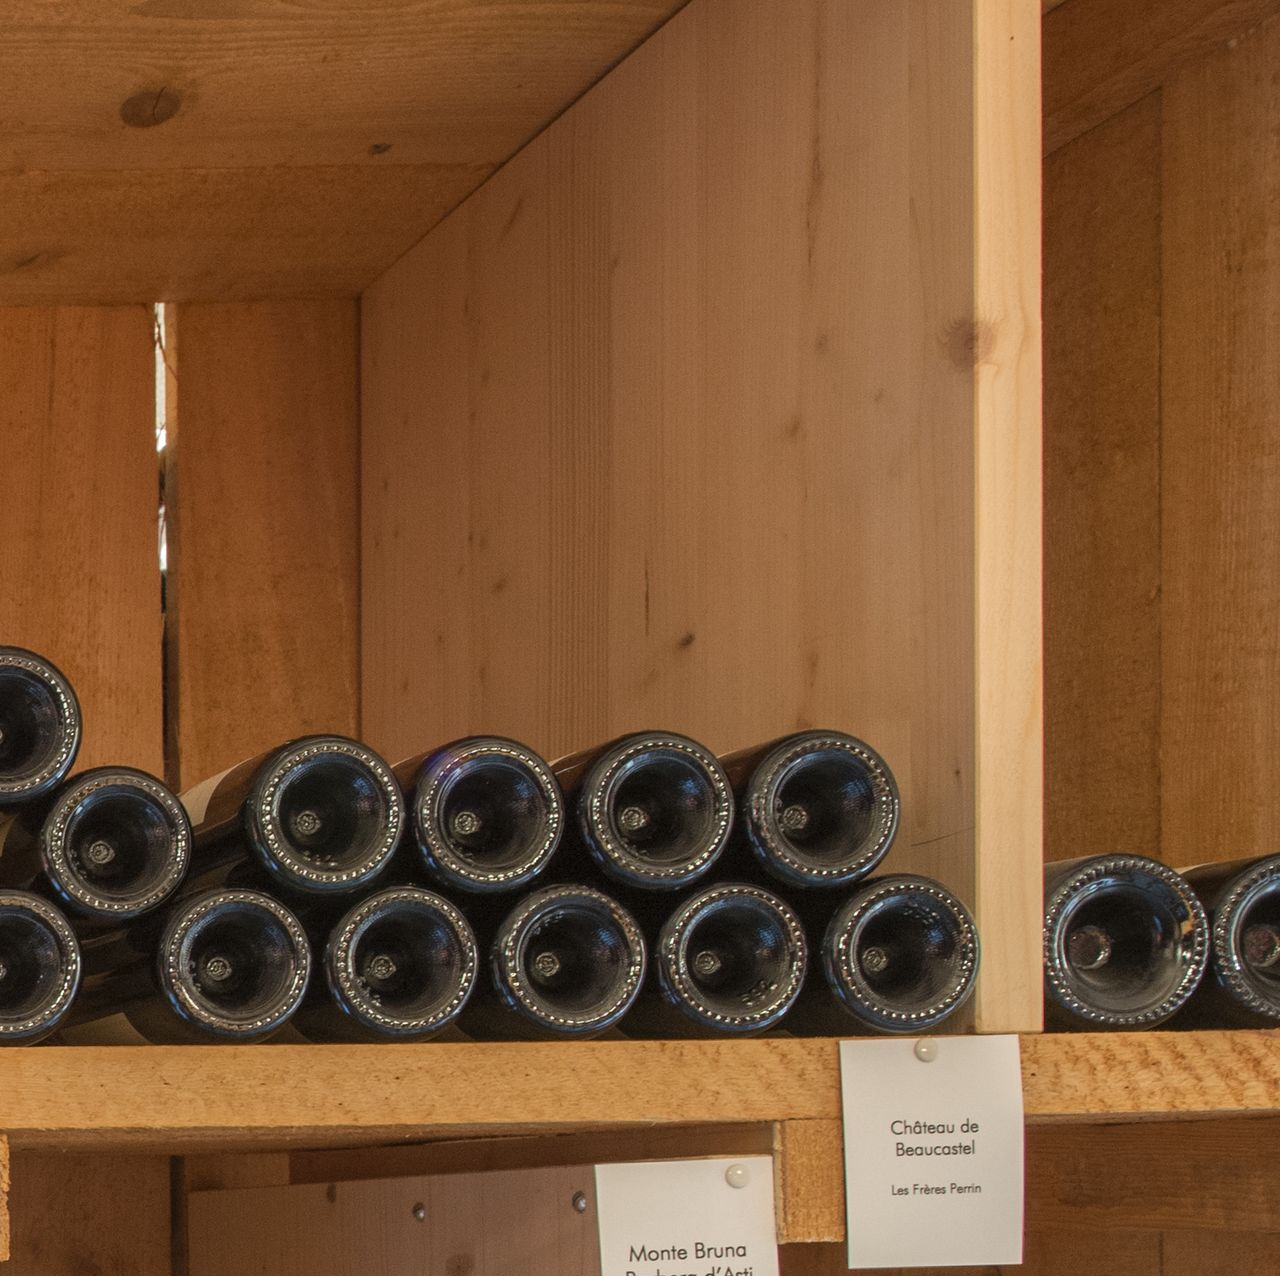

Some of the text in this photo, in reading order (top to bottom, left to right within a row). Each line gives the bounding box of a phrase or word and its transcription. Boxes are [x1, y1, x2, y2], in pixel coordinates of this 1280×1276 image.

[890, 1118, 980, 1136] Château de
[895, 1139, 976, 1157] Beaucastel
[892, 1182, 982, 1196] Les Frères Perrin
[629, 1242, 747, 1263] Monte Bruna
